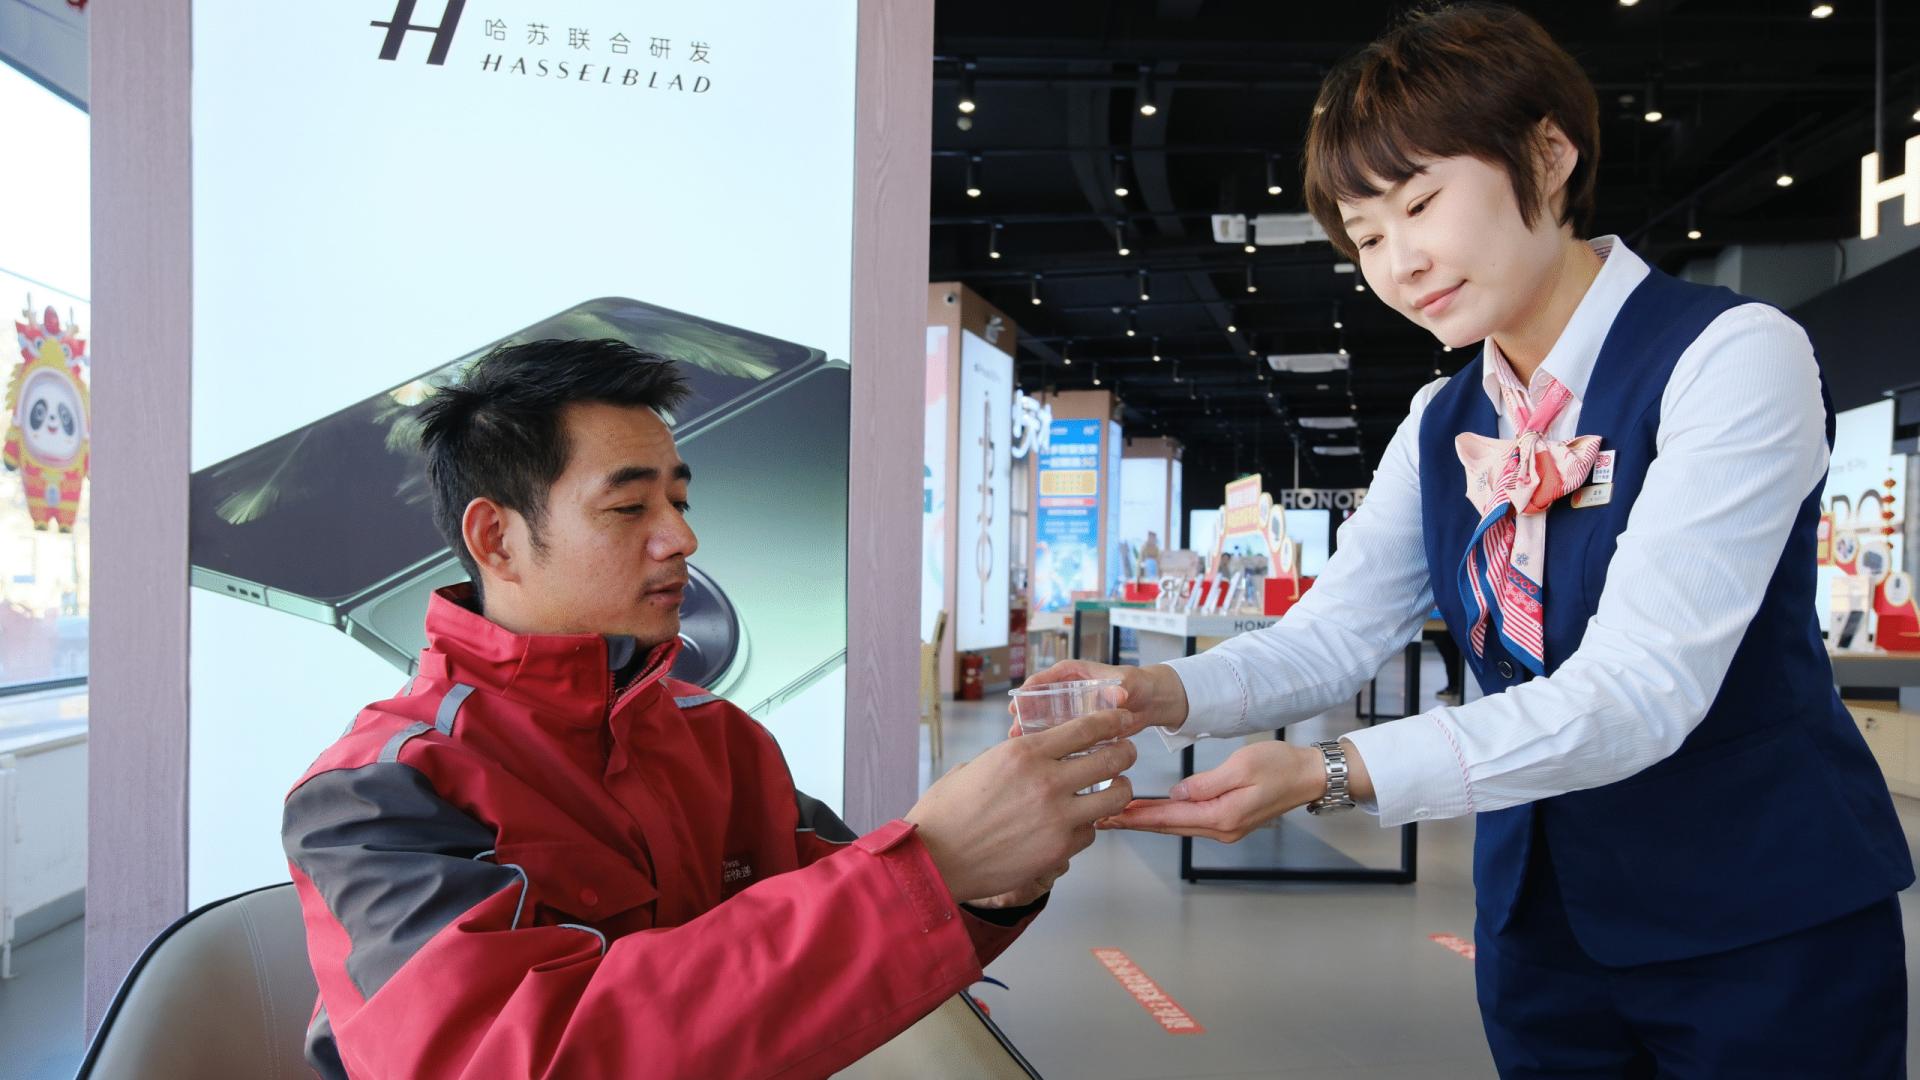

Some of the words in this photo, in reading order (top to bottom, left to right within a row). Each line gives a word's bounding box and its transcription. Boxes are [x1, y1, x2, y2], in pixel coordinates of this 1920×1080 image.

[485, 18, 711, 64] 哈苏联合研发
[480, 53, 712, 94] HASSELBLAD
